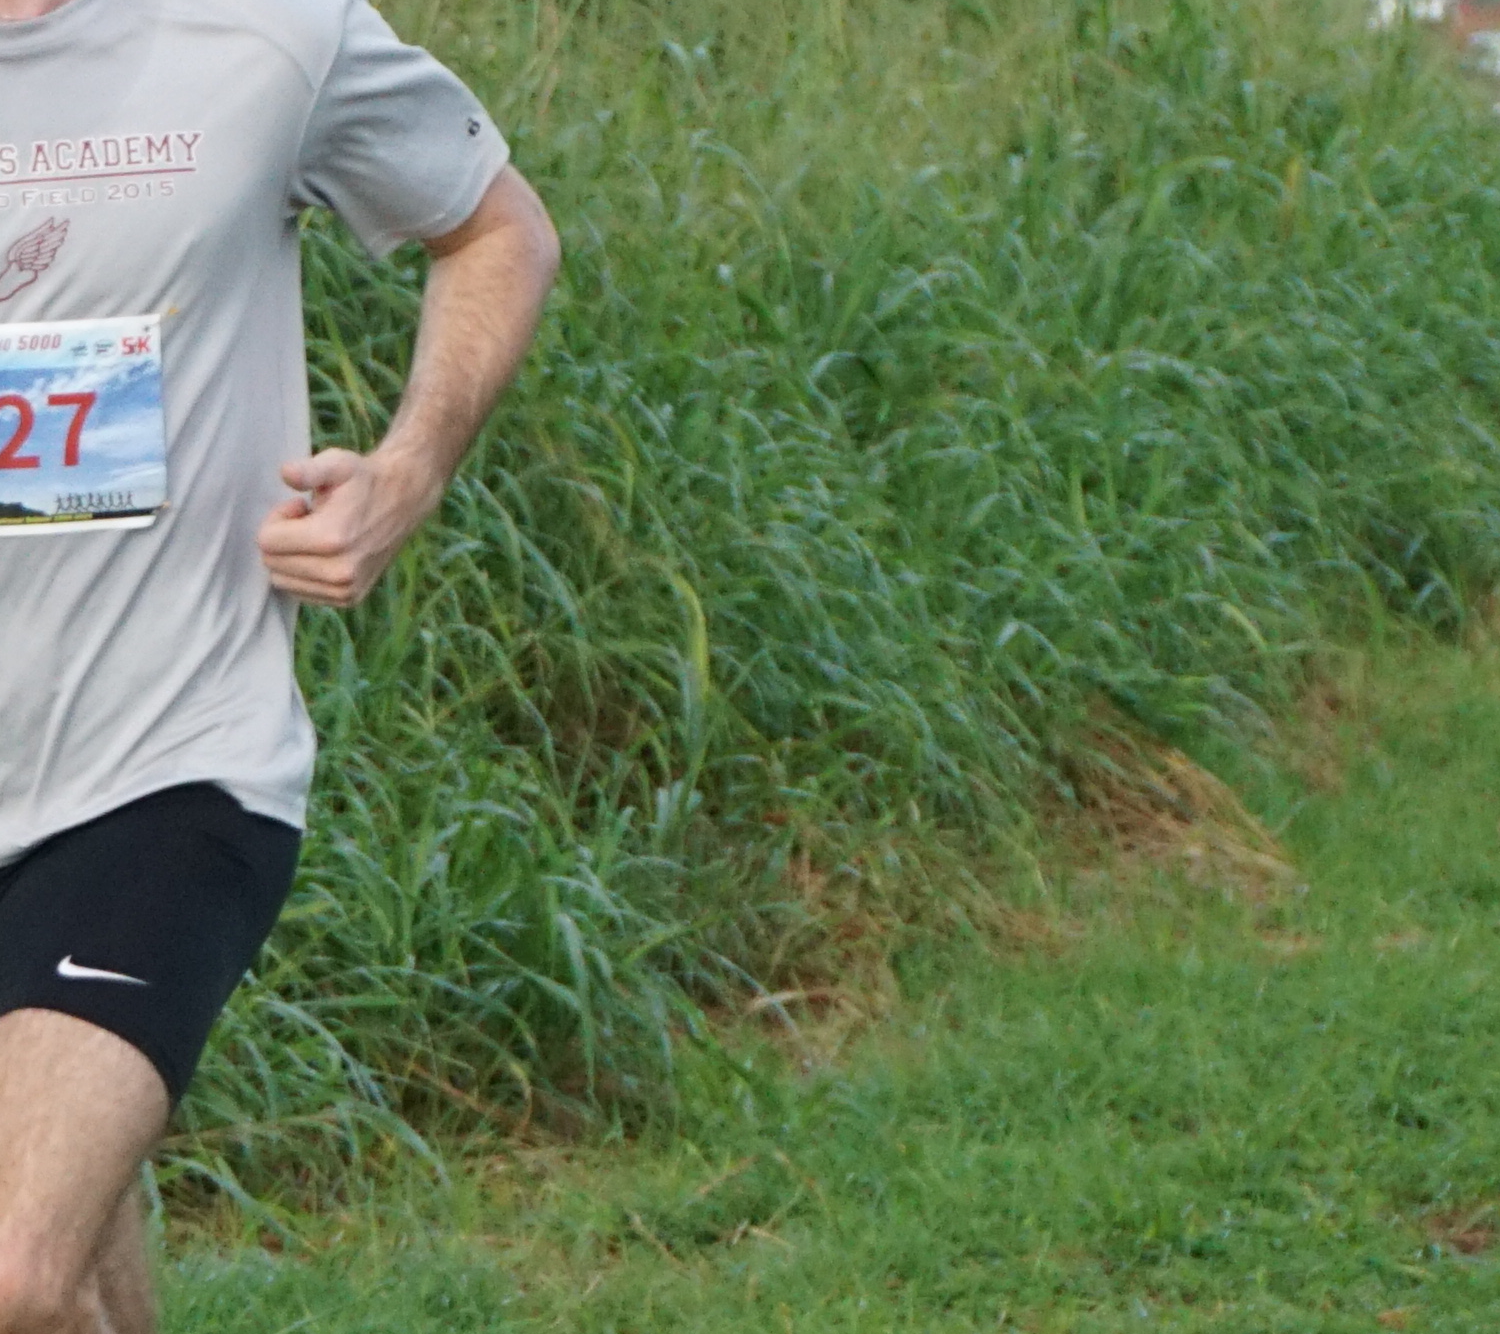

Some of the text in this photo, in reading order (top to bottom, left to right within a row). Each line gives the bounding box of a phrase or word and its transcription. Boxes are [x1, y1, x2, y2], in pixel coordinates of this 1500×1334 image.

[31, 132, 202, 173] ACADEMY
[21, 188, 96, 207] FIELD
[107, 180, 174, 202] 2015
[17, 333, 62, 351] 5000
